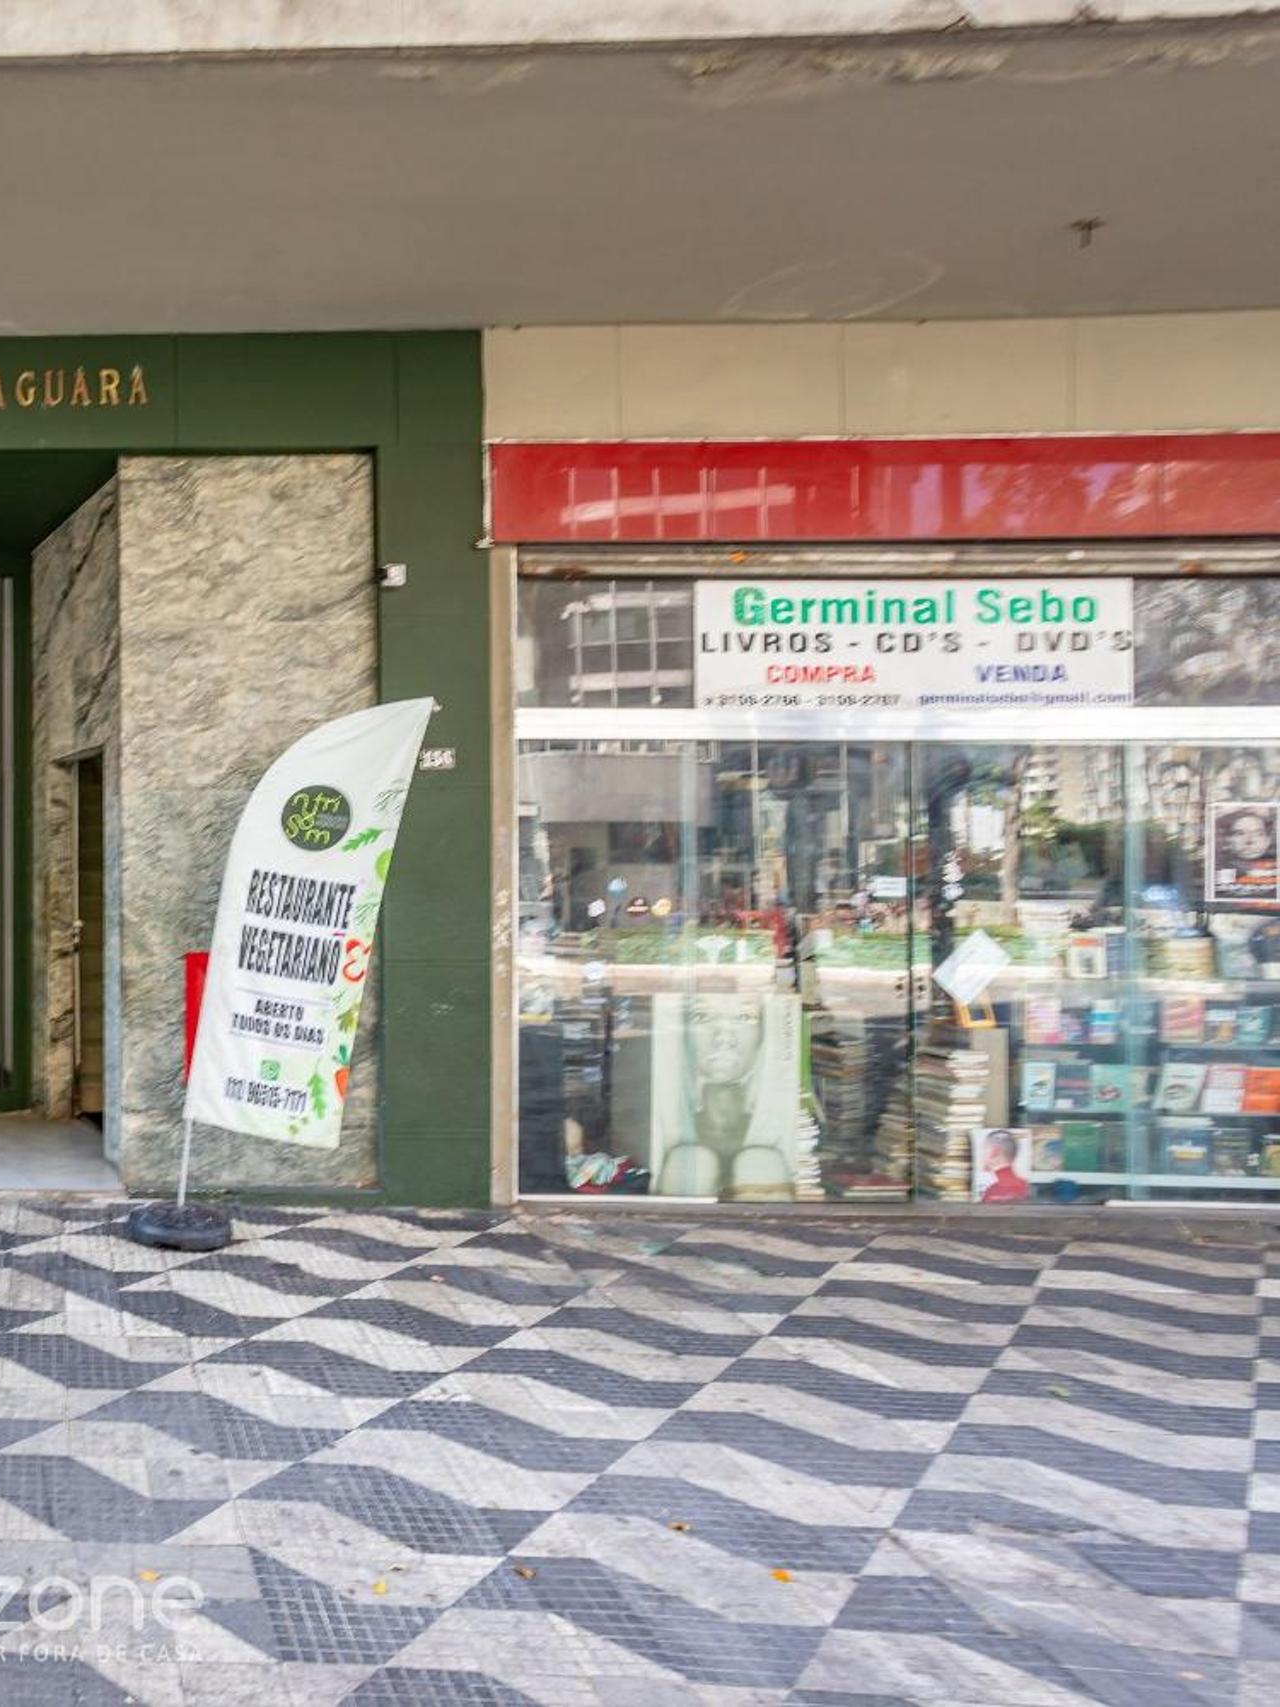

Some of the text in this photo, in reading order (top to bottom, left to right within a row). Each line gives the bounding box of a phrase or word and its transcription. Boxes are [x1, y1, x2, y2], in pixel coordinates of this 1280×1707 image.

[732, 586, 1098, 626] Germinal Sebo
[701, 631, 833, 654] LIVROS
[876, 630, 963, 654] CD'S
[1014, 629, 1132, 652] DVD'S
[766, 663, 1068, 685] COMPRA VENDA
[245, 869, 357, 930] RESTAURANTE
[238, 924, 341, 986] VEGETARIANO
[255, 999, 304, 1021] ABERTO
[231, 1012, 325, 1045] TODOS OS DIAS
